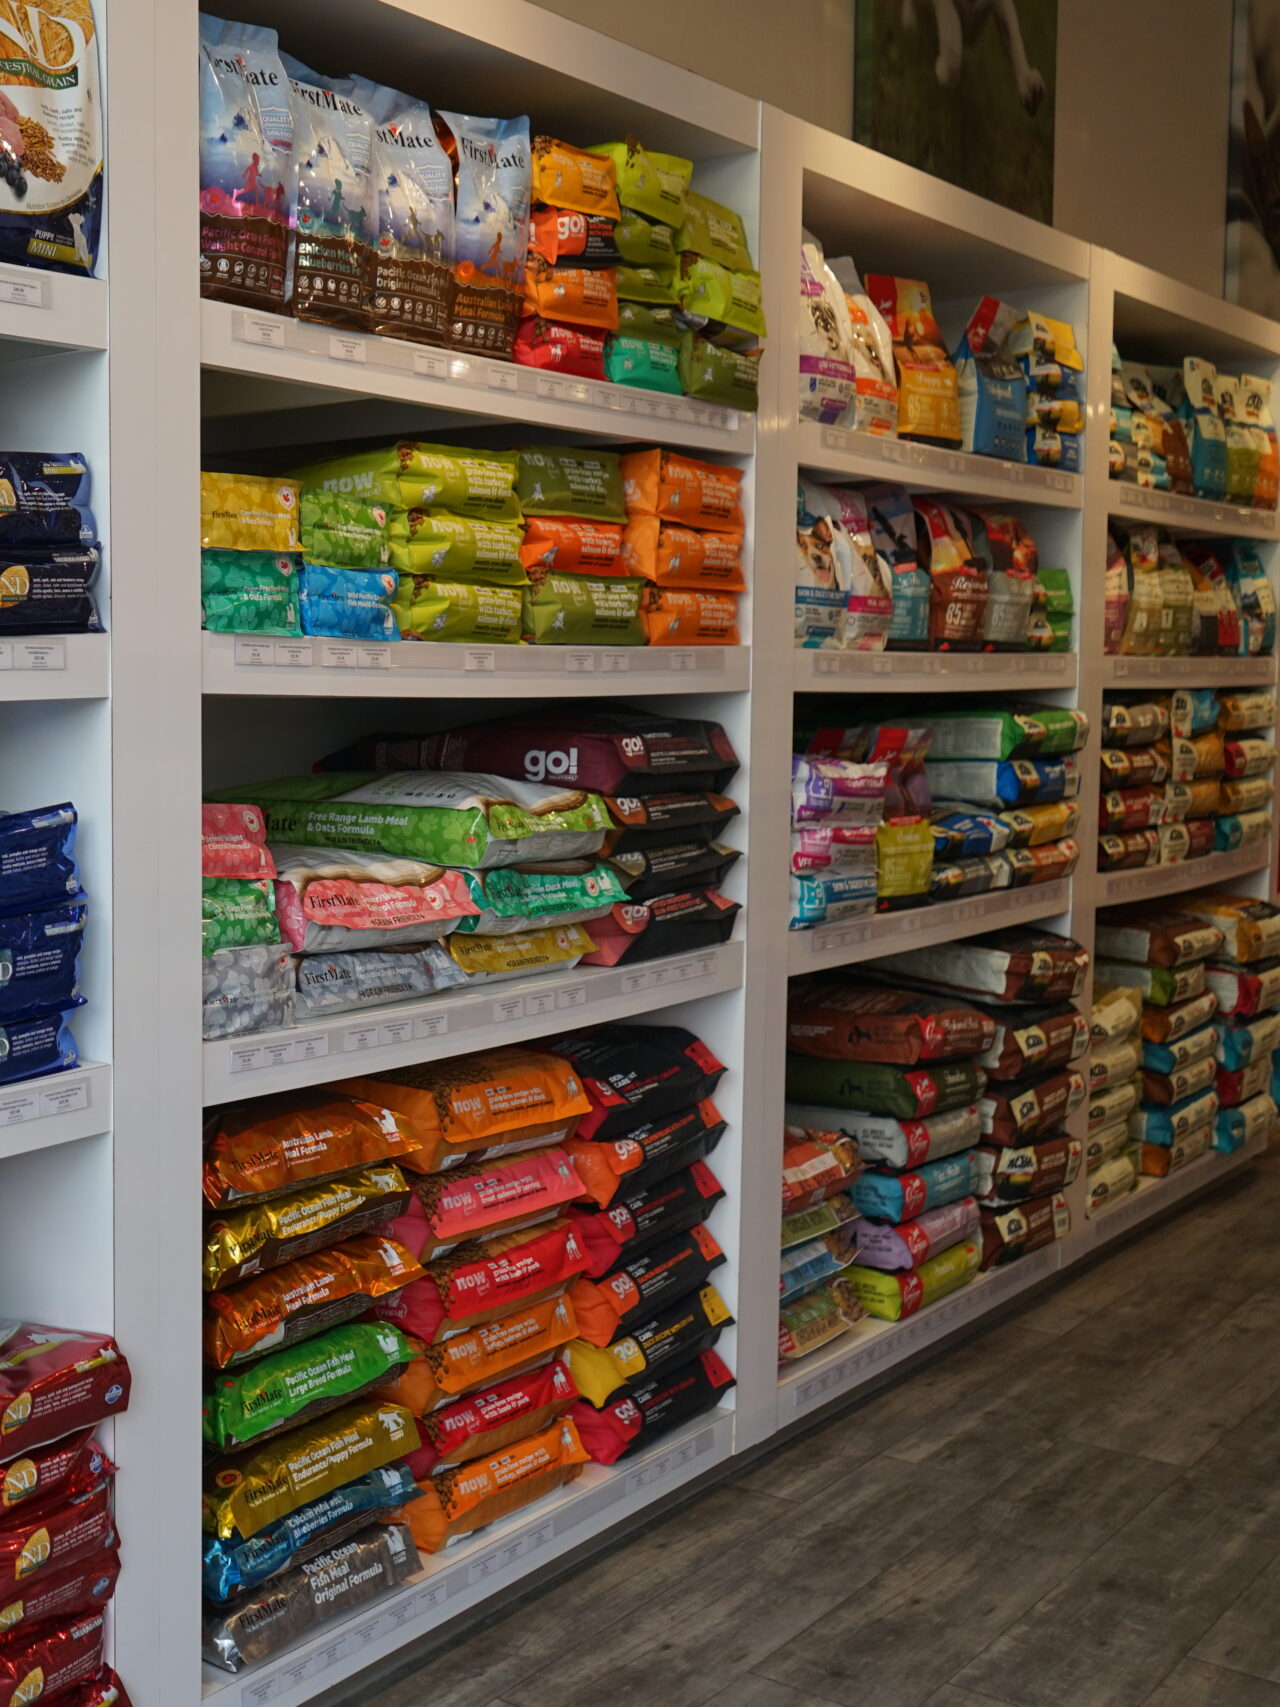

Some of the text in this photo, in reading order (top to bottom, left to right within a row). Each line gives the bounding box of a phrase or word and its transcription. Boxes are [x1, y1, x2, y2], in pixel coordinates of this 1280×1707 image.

[44, 75, 77, 88] GRAIN
[35, 230, 55, 241] PUPPY
[31, 242, 57, 257] MINI
[376, 266, 427, 282] Pacific Ocean
[376, 277, 437, 296] Original Formula
[420, 455, 455, 470] now
[323, 471, 376, 494] now
[431, 518, 465, 534] now
[436, 582, 469, 597] now
[550, 579, 582, 594] now
[946, 604, 961, 625] 85
[307, 823, 314, 831] &
[337, 824, 375, 835] Formula
[308, 812, 409, 826] Free Range Lamb Meal
[309, 894, 361, 909] FirstMate
[304, 968, 352, 985] FirstMate
[364, 984, 412, 999] GRAIN FRIENDLY
[452, 1096, 483, 1114] now
[282, 1129, 334, 1149] Australian Lamb
[230, 1149, 281, 1170] FirstMate
[278, 1189, 352, 1226] Pacific Ocean Fish Meal
[442, 1190, 475, 1210] now
[282, 1273, 335, 1302] Australian Lamb
[455, 1270, 487, 1292] now
[449, 1338, 481, 1361] now
[285, 1351, 356, 1387] Pacific Ocean Fish Meal
[289, 1365, 352, 1398] Large Breed Formula
[240, 1387, 283, 1412] FirstMate
[443, 1409, 477, 1432] now
[288, 1432, 360, 1472] Pacific Ocean Fish Meal
[348, 1437, 373, 1457] Formula
[243, 1474, 288, 1505] FirstMate
[458, 1472, 493, 1495] now
[301, 1543, 359, 1576] Pacific Ocean
[310, 1562, 350, 1590] Fish Meal
[314, 1562, 383, 1605] Original Formula
[237, 1594, 288, 1629] FirstMate
